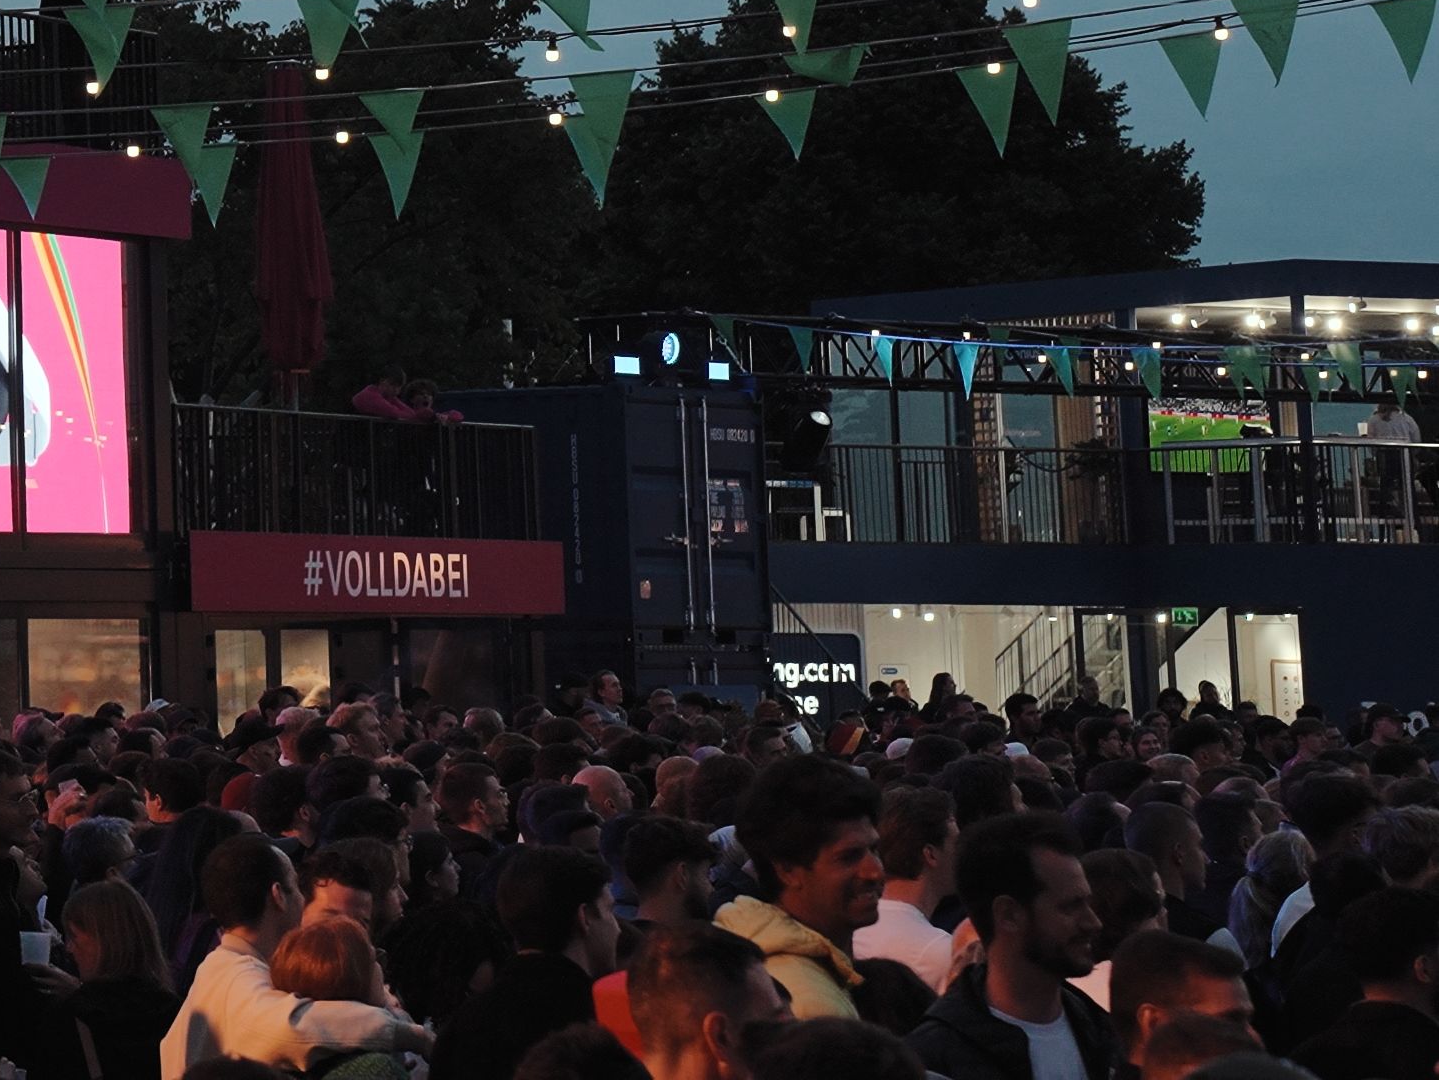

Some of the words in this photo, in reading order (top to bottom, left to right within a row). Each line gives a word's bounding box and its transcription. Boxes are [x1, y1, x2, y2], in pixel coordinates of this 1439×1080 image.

[570, 433, 579, 485] HBSU
[572, 487, 582, 565] 082420
[303, 550, 469, 599] #VOLLDABEI
[767, 657, 856, 688] ng.com
